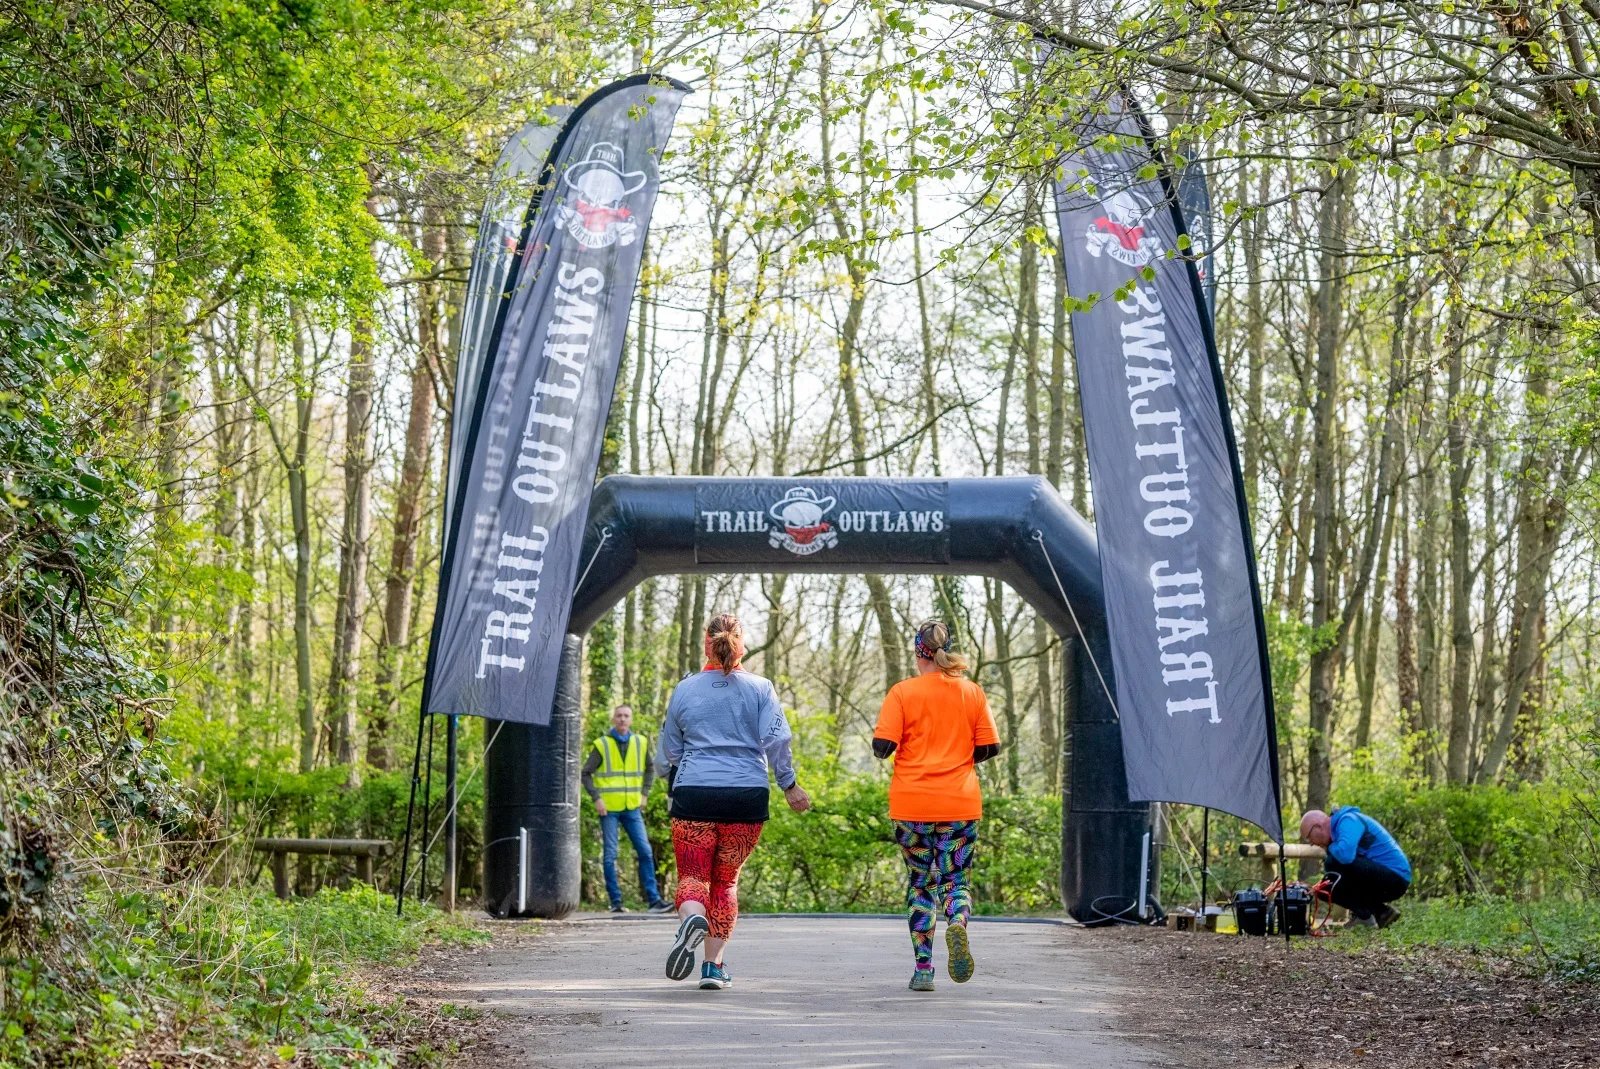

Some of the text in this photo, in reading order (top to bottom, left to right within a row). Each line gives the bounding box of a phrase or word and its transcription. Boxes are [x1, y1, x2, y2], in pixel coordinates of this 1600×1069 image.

[597, 149, 617, 163] TRAIL
[570, 222, 615, 246] OUTLAWS
[475, 262, 606, 679] TRAIL OUTLAWS
[701, 510, 944, 532] TRAIL OUTLAWS
[785, 539, 823, 553] OUTLAWS
